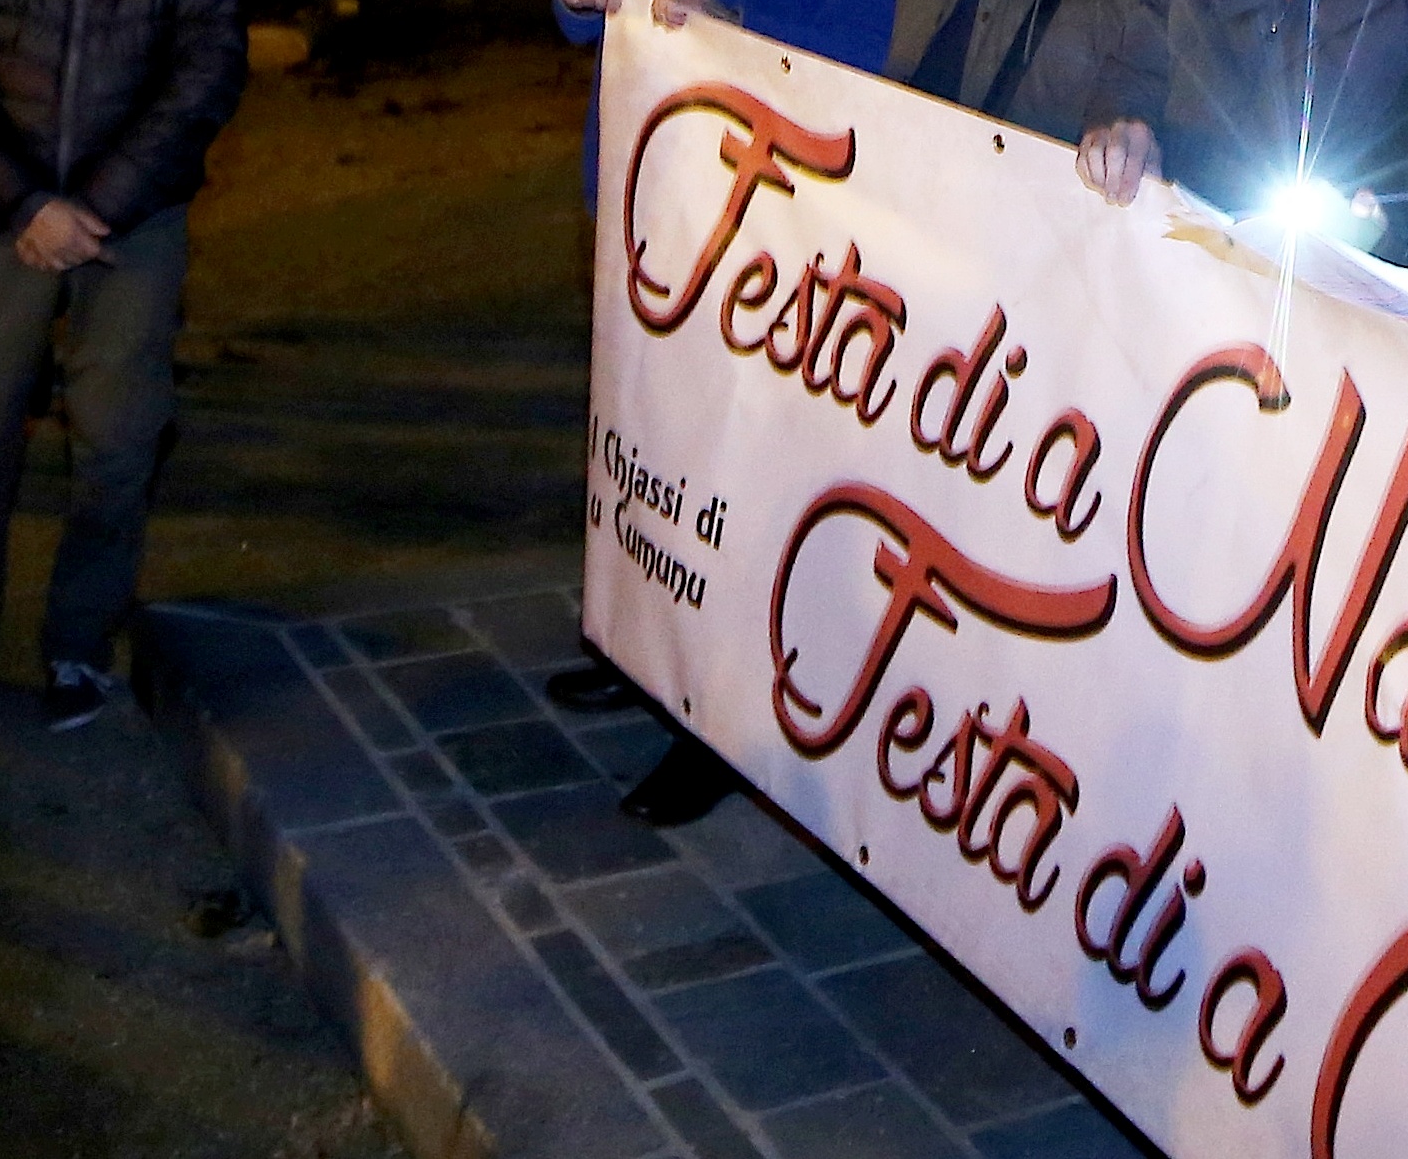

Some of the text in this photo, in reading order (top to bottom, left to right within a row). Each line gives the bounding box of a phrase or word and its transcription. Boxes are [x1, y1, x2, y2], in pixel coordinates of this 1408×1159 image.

[604, 429, 687, 526] Chjassi
[696, 495, 728, 551] di
[625, 81, 907, 425] Festa
[910, 302, 1028, 483] di
[1025, 406, 1103, 543] a
[769, 479, 1288, 1107] Festa di a
